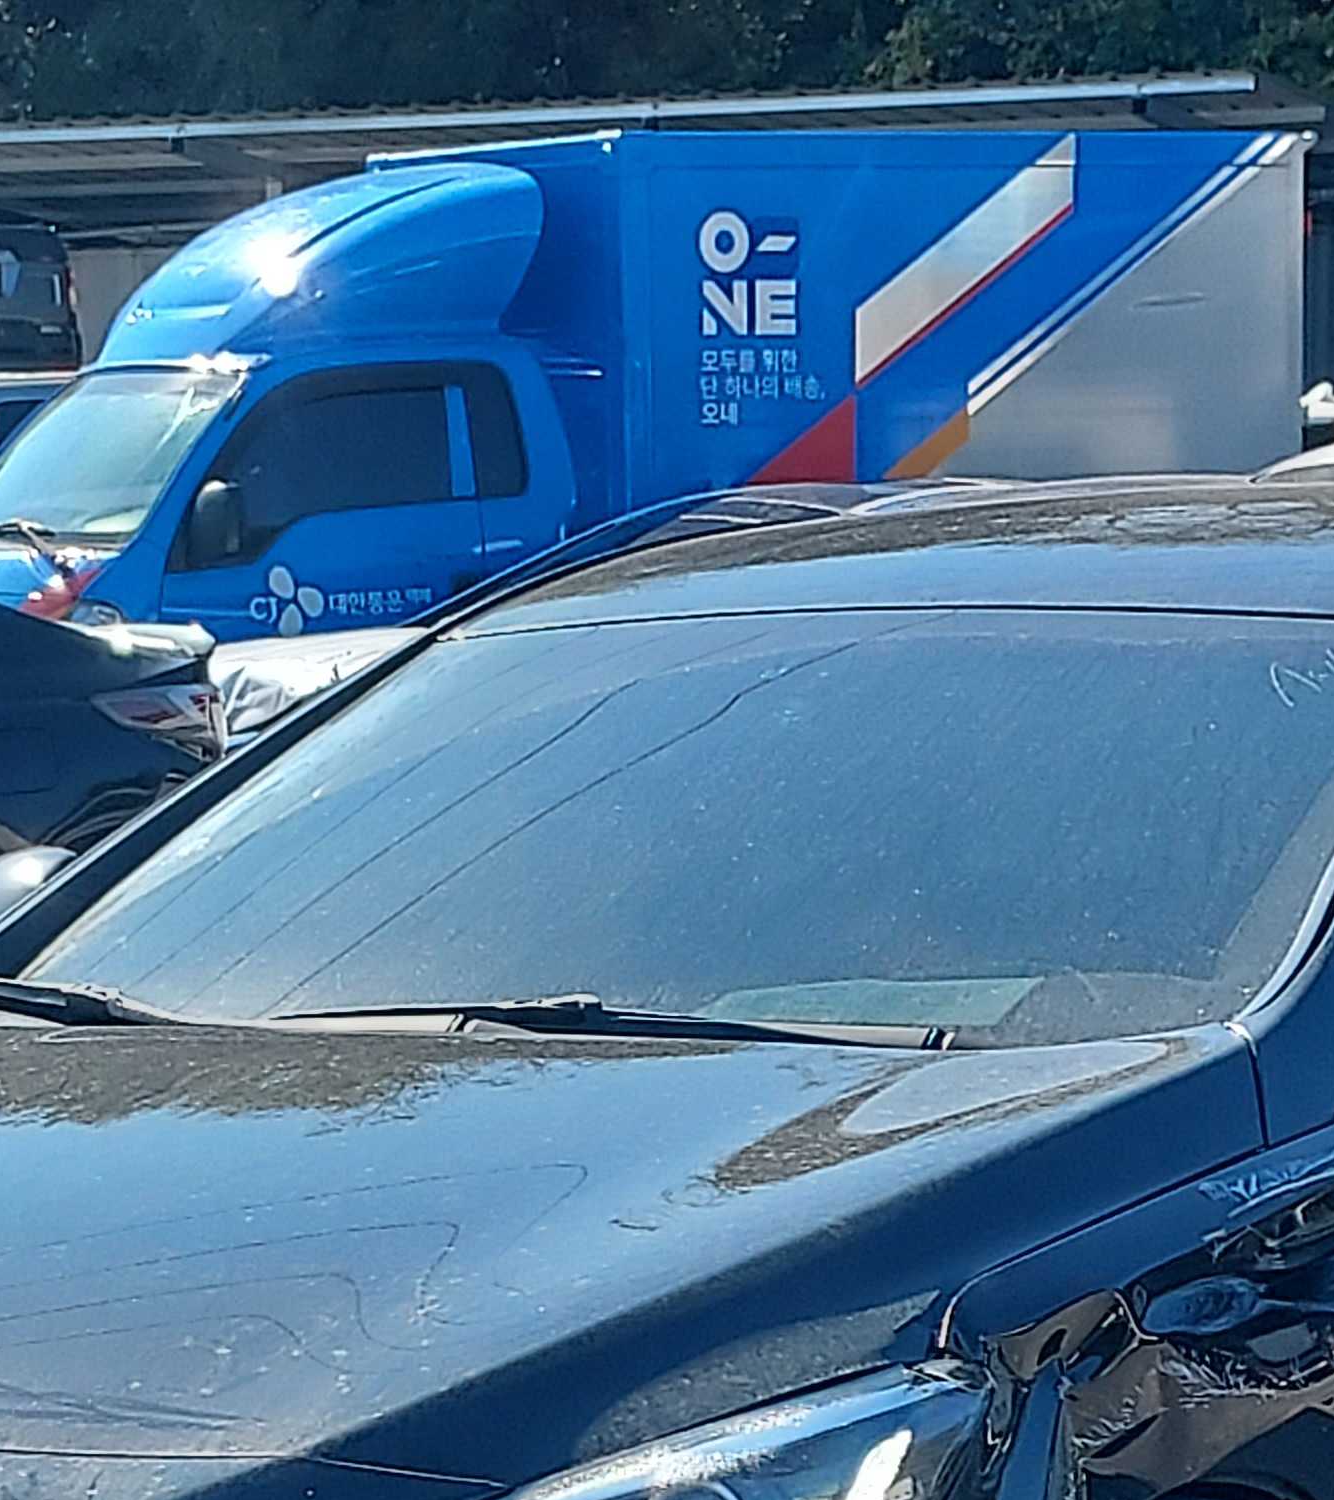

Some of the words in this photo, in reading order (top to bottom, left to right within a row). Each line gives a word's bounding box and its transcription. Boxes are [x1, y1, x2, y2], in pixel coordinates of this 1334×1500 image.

[700, 350, 755, 374] 모두를
[762, 349, 798, 373] 위한
[699, 375, 718, 400] 단
[725, 374, 779, 400] 하나의
[700, 402, 739, 425] 오네
[250, 597, 278, 624] CJ
[328, 589, 404, 615] 대한통운
